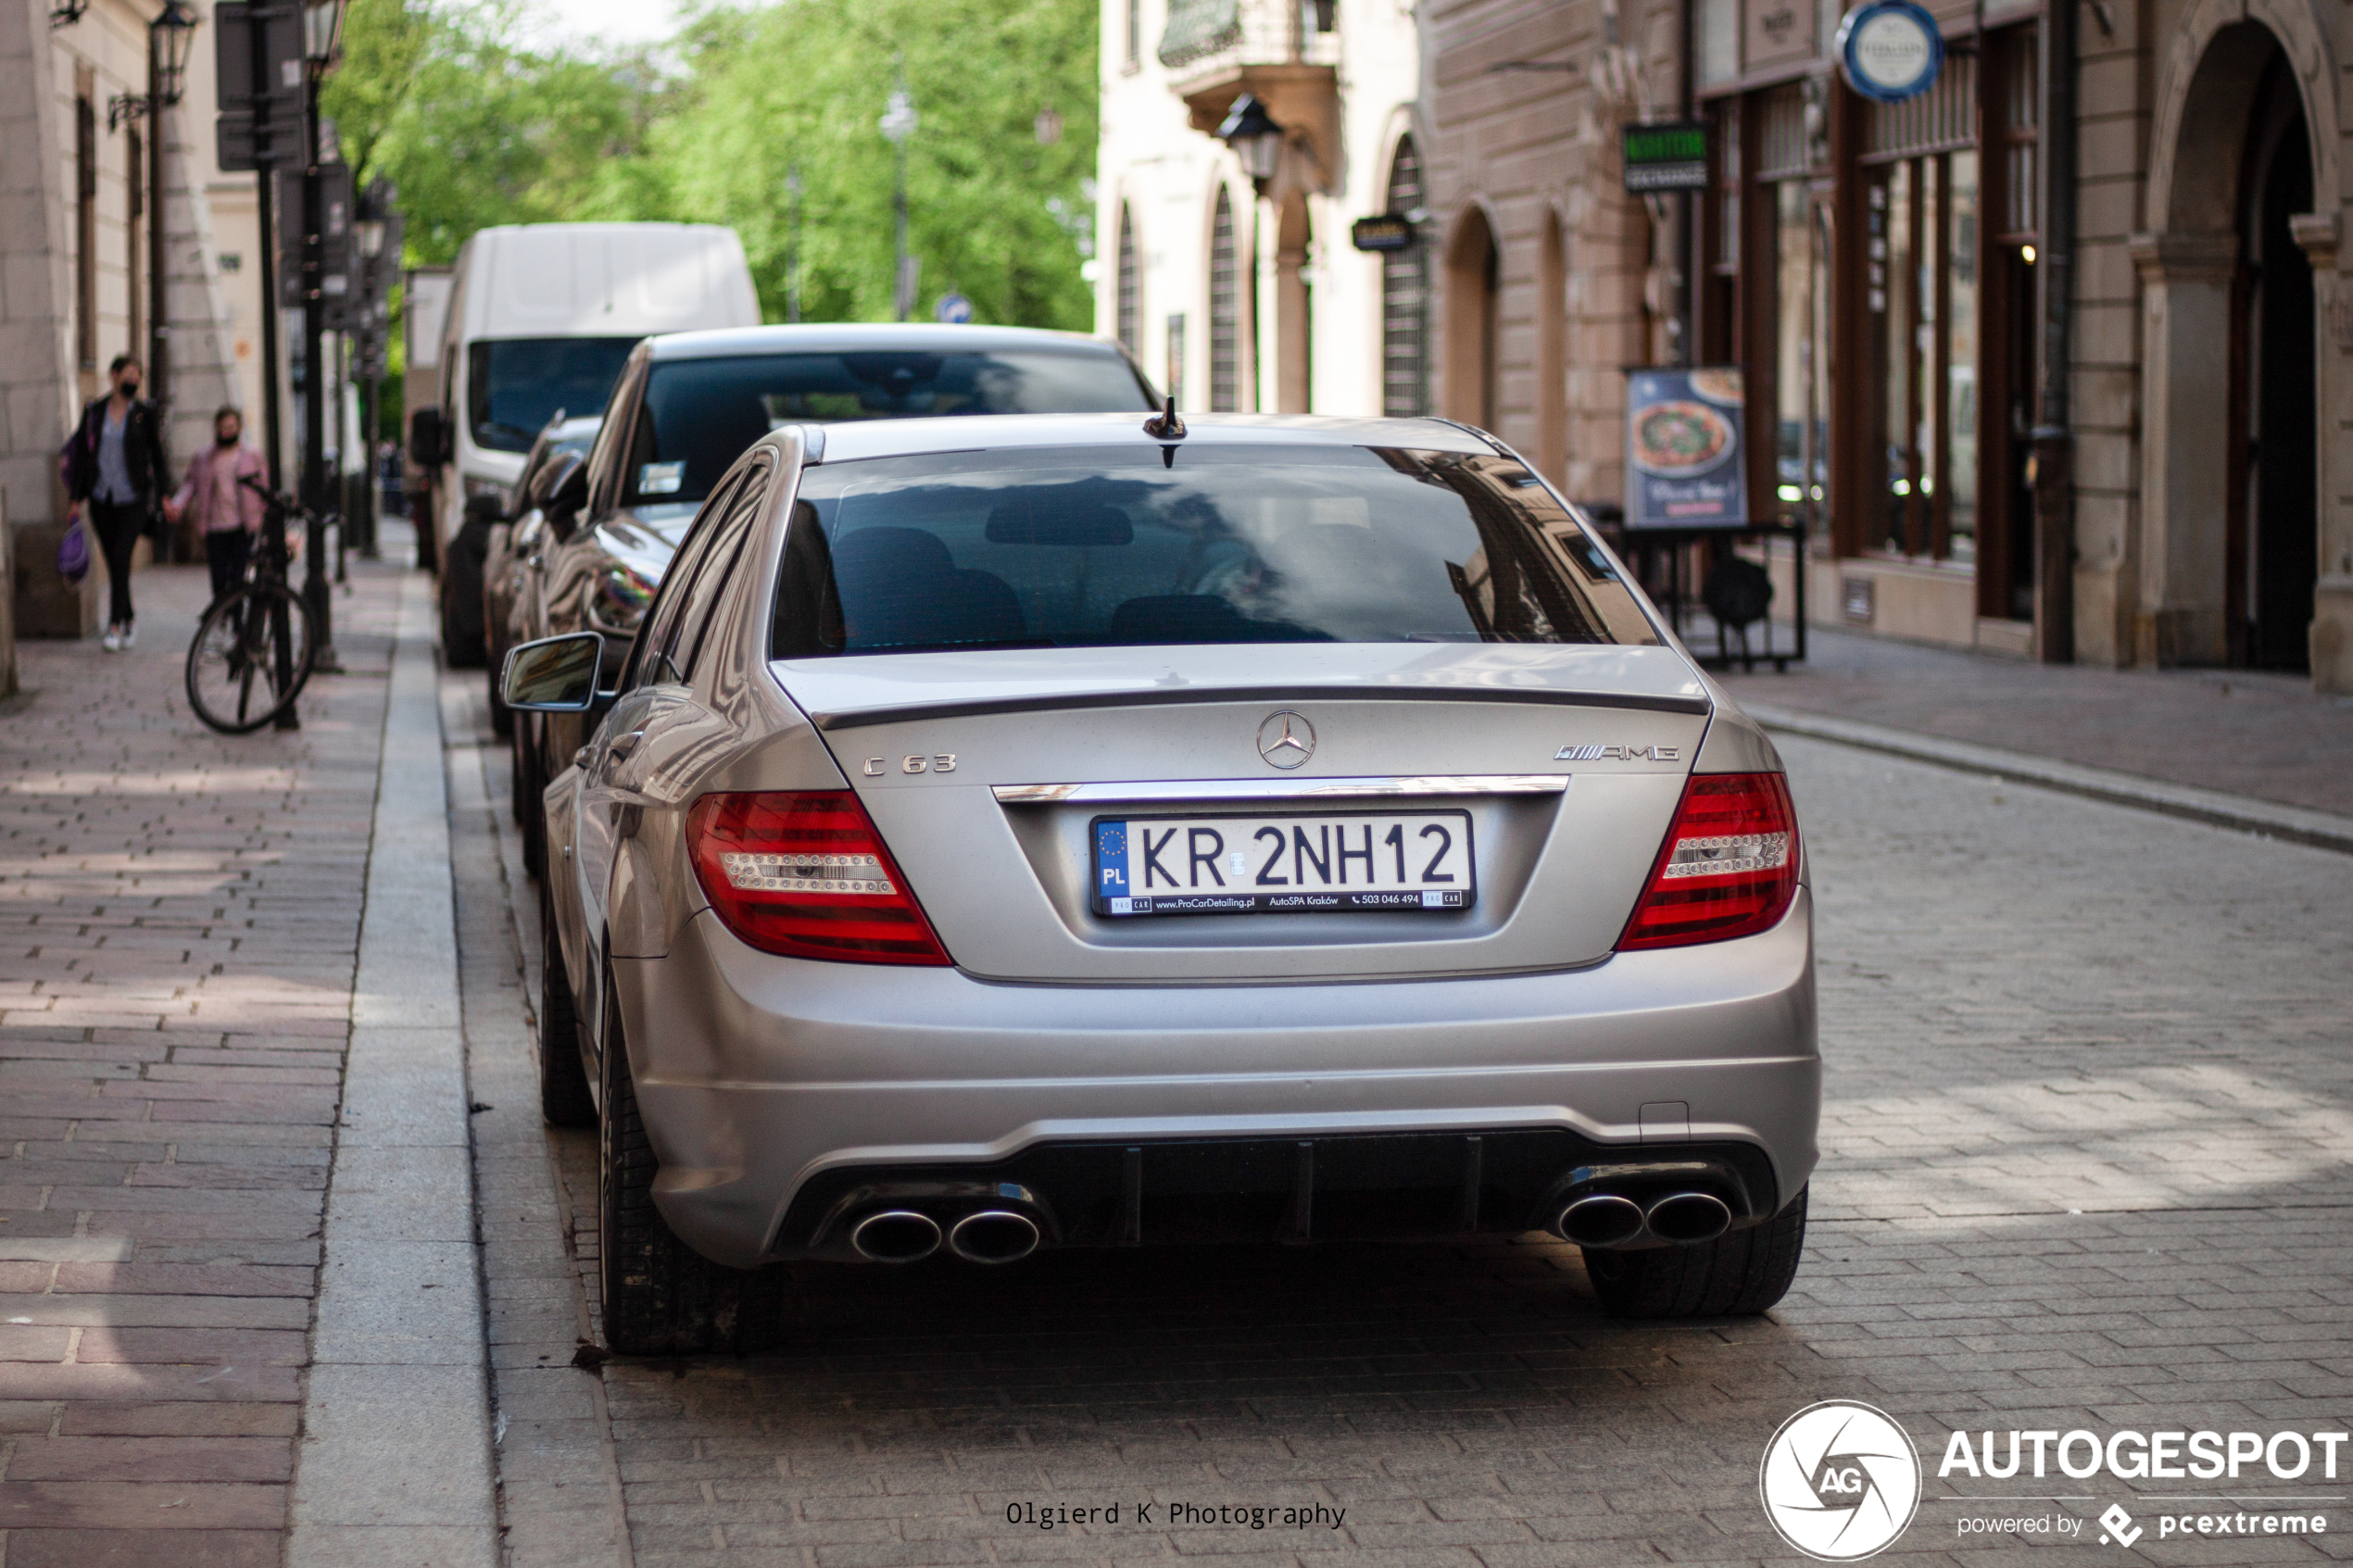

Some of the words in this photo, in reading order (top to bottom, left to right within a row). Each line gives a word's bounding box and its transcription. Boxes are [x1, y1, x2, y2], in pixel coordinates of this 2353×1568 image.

[863, 757, 886, 776] C
[902, 753, 956, 774] 63
[1142, 826, 1227, 889] KR
[1252, 823, 1455, 886] 2NH12
[1103, 868, 1126, 884] PL
[1134, 900, 1149, 909] CAR
[1156, 897, 1255, 909] www.ProCarDetailing.pl
[1269, 896, 1305, 906] AutoSPA
[1307, 895, 1339, 905] Kraków
[1362, 895, 1379, 904] 503
[1381, 895, 1399, 904] 046
[1402, 894, 1418, 903] 494
